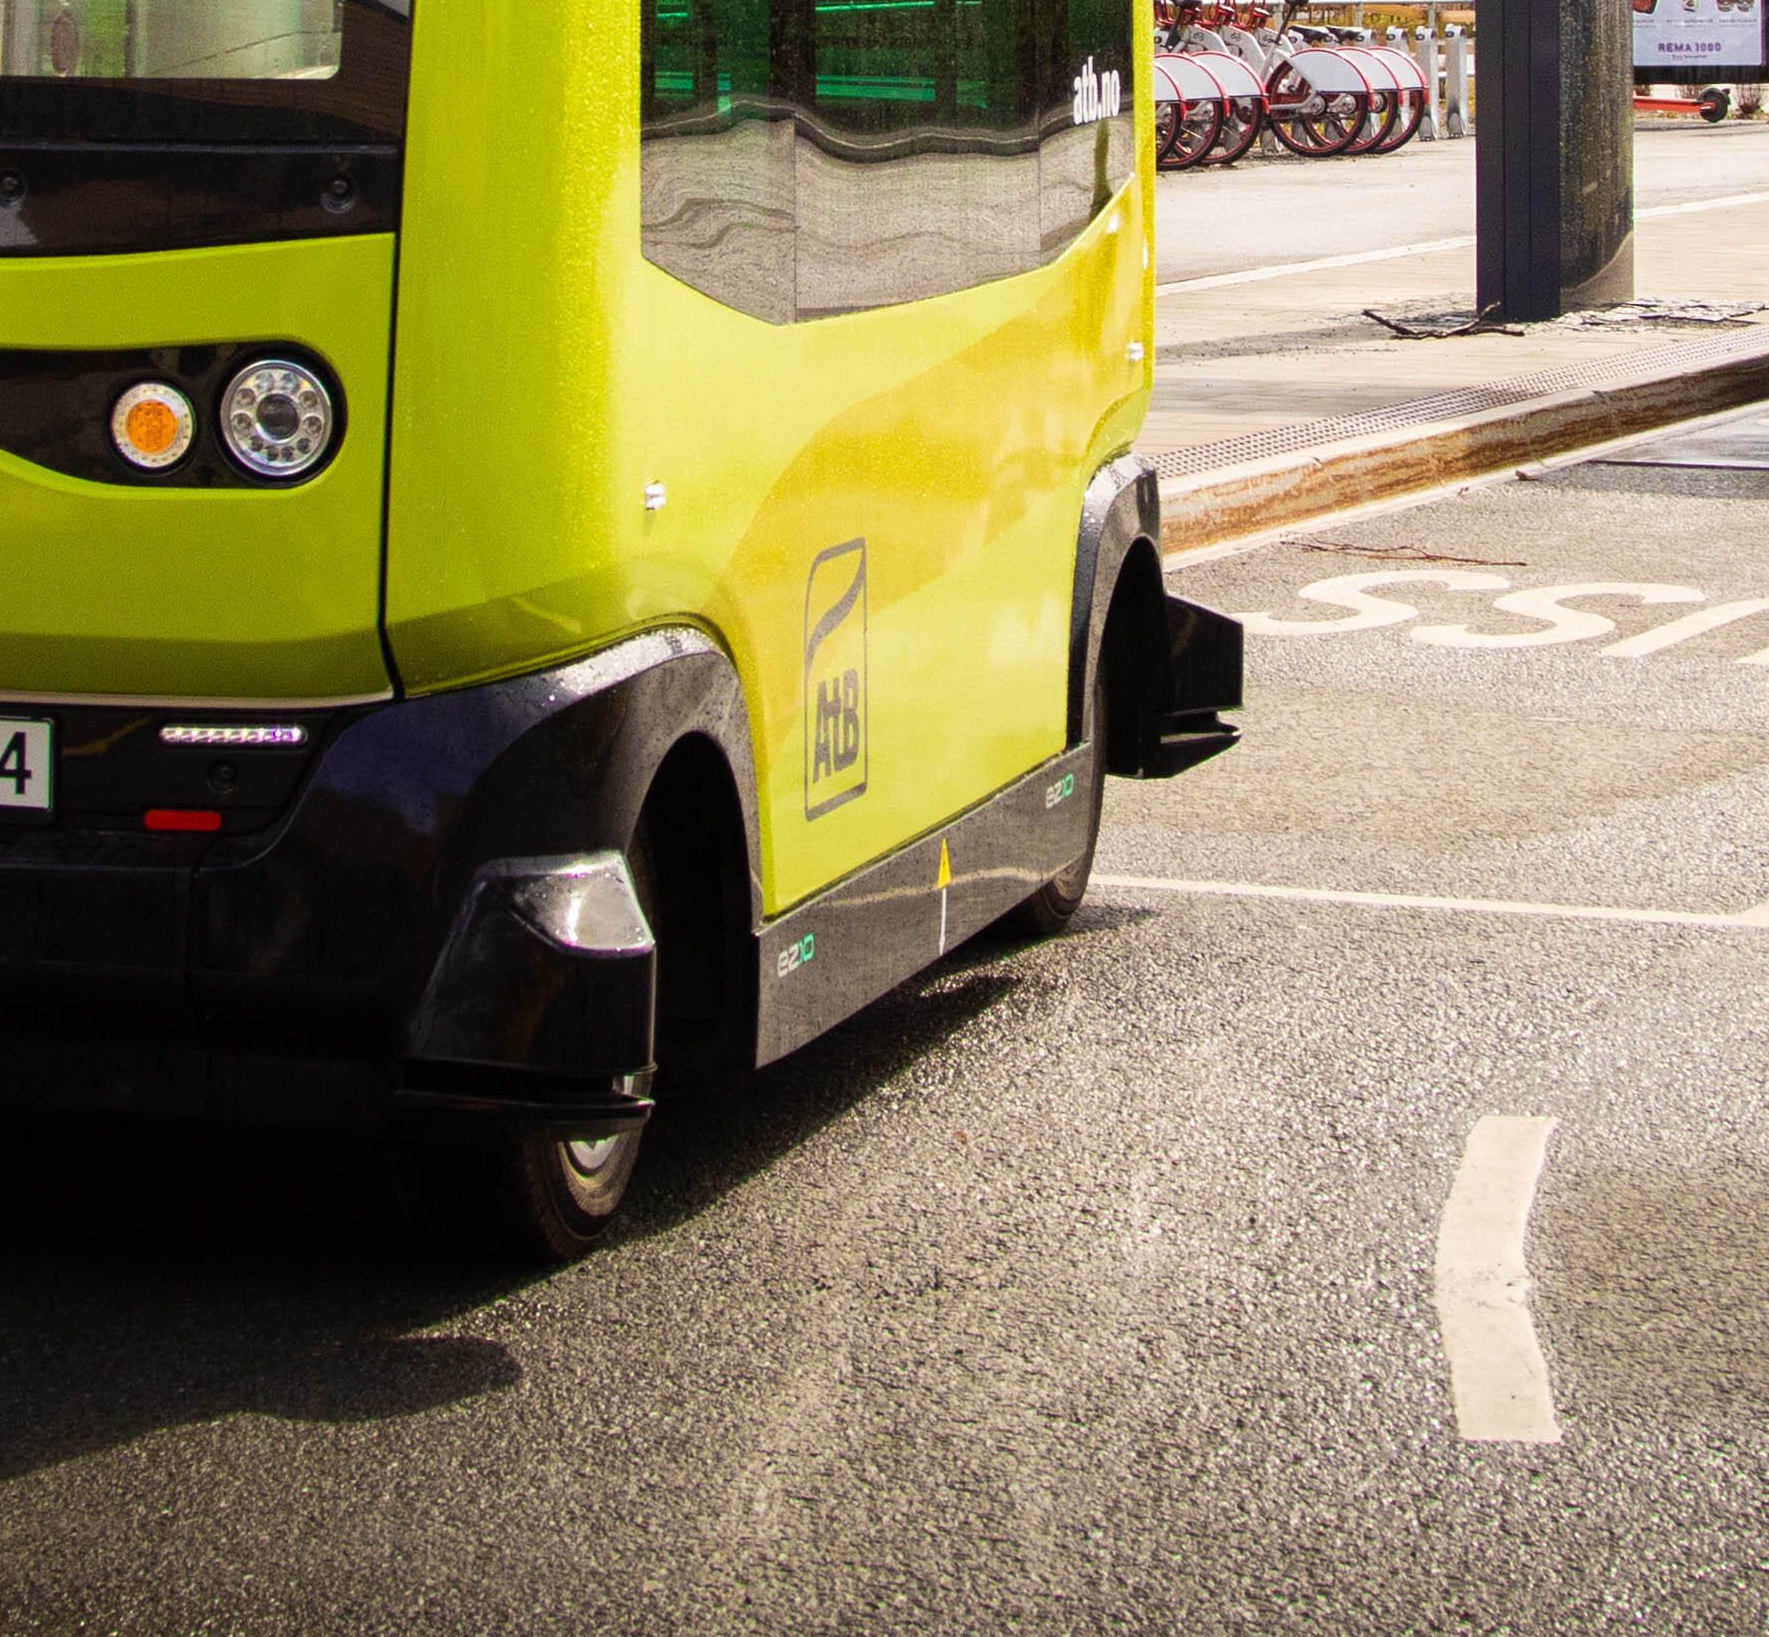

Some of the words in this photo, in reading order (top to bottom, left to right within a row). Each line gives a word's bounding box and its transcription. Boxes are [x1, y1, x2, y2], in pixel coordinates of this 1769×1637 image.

[1658, 42, 1692, 52] REMA
[1695, 42, 1721, 52] 1000
[1073, 55, 1120, 125] atb.no
[812, 668, 859, 784] AtB
